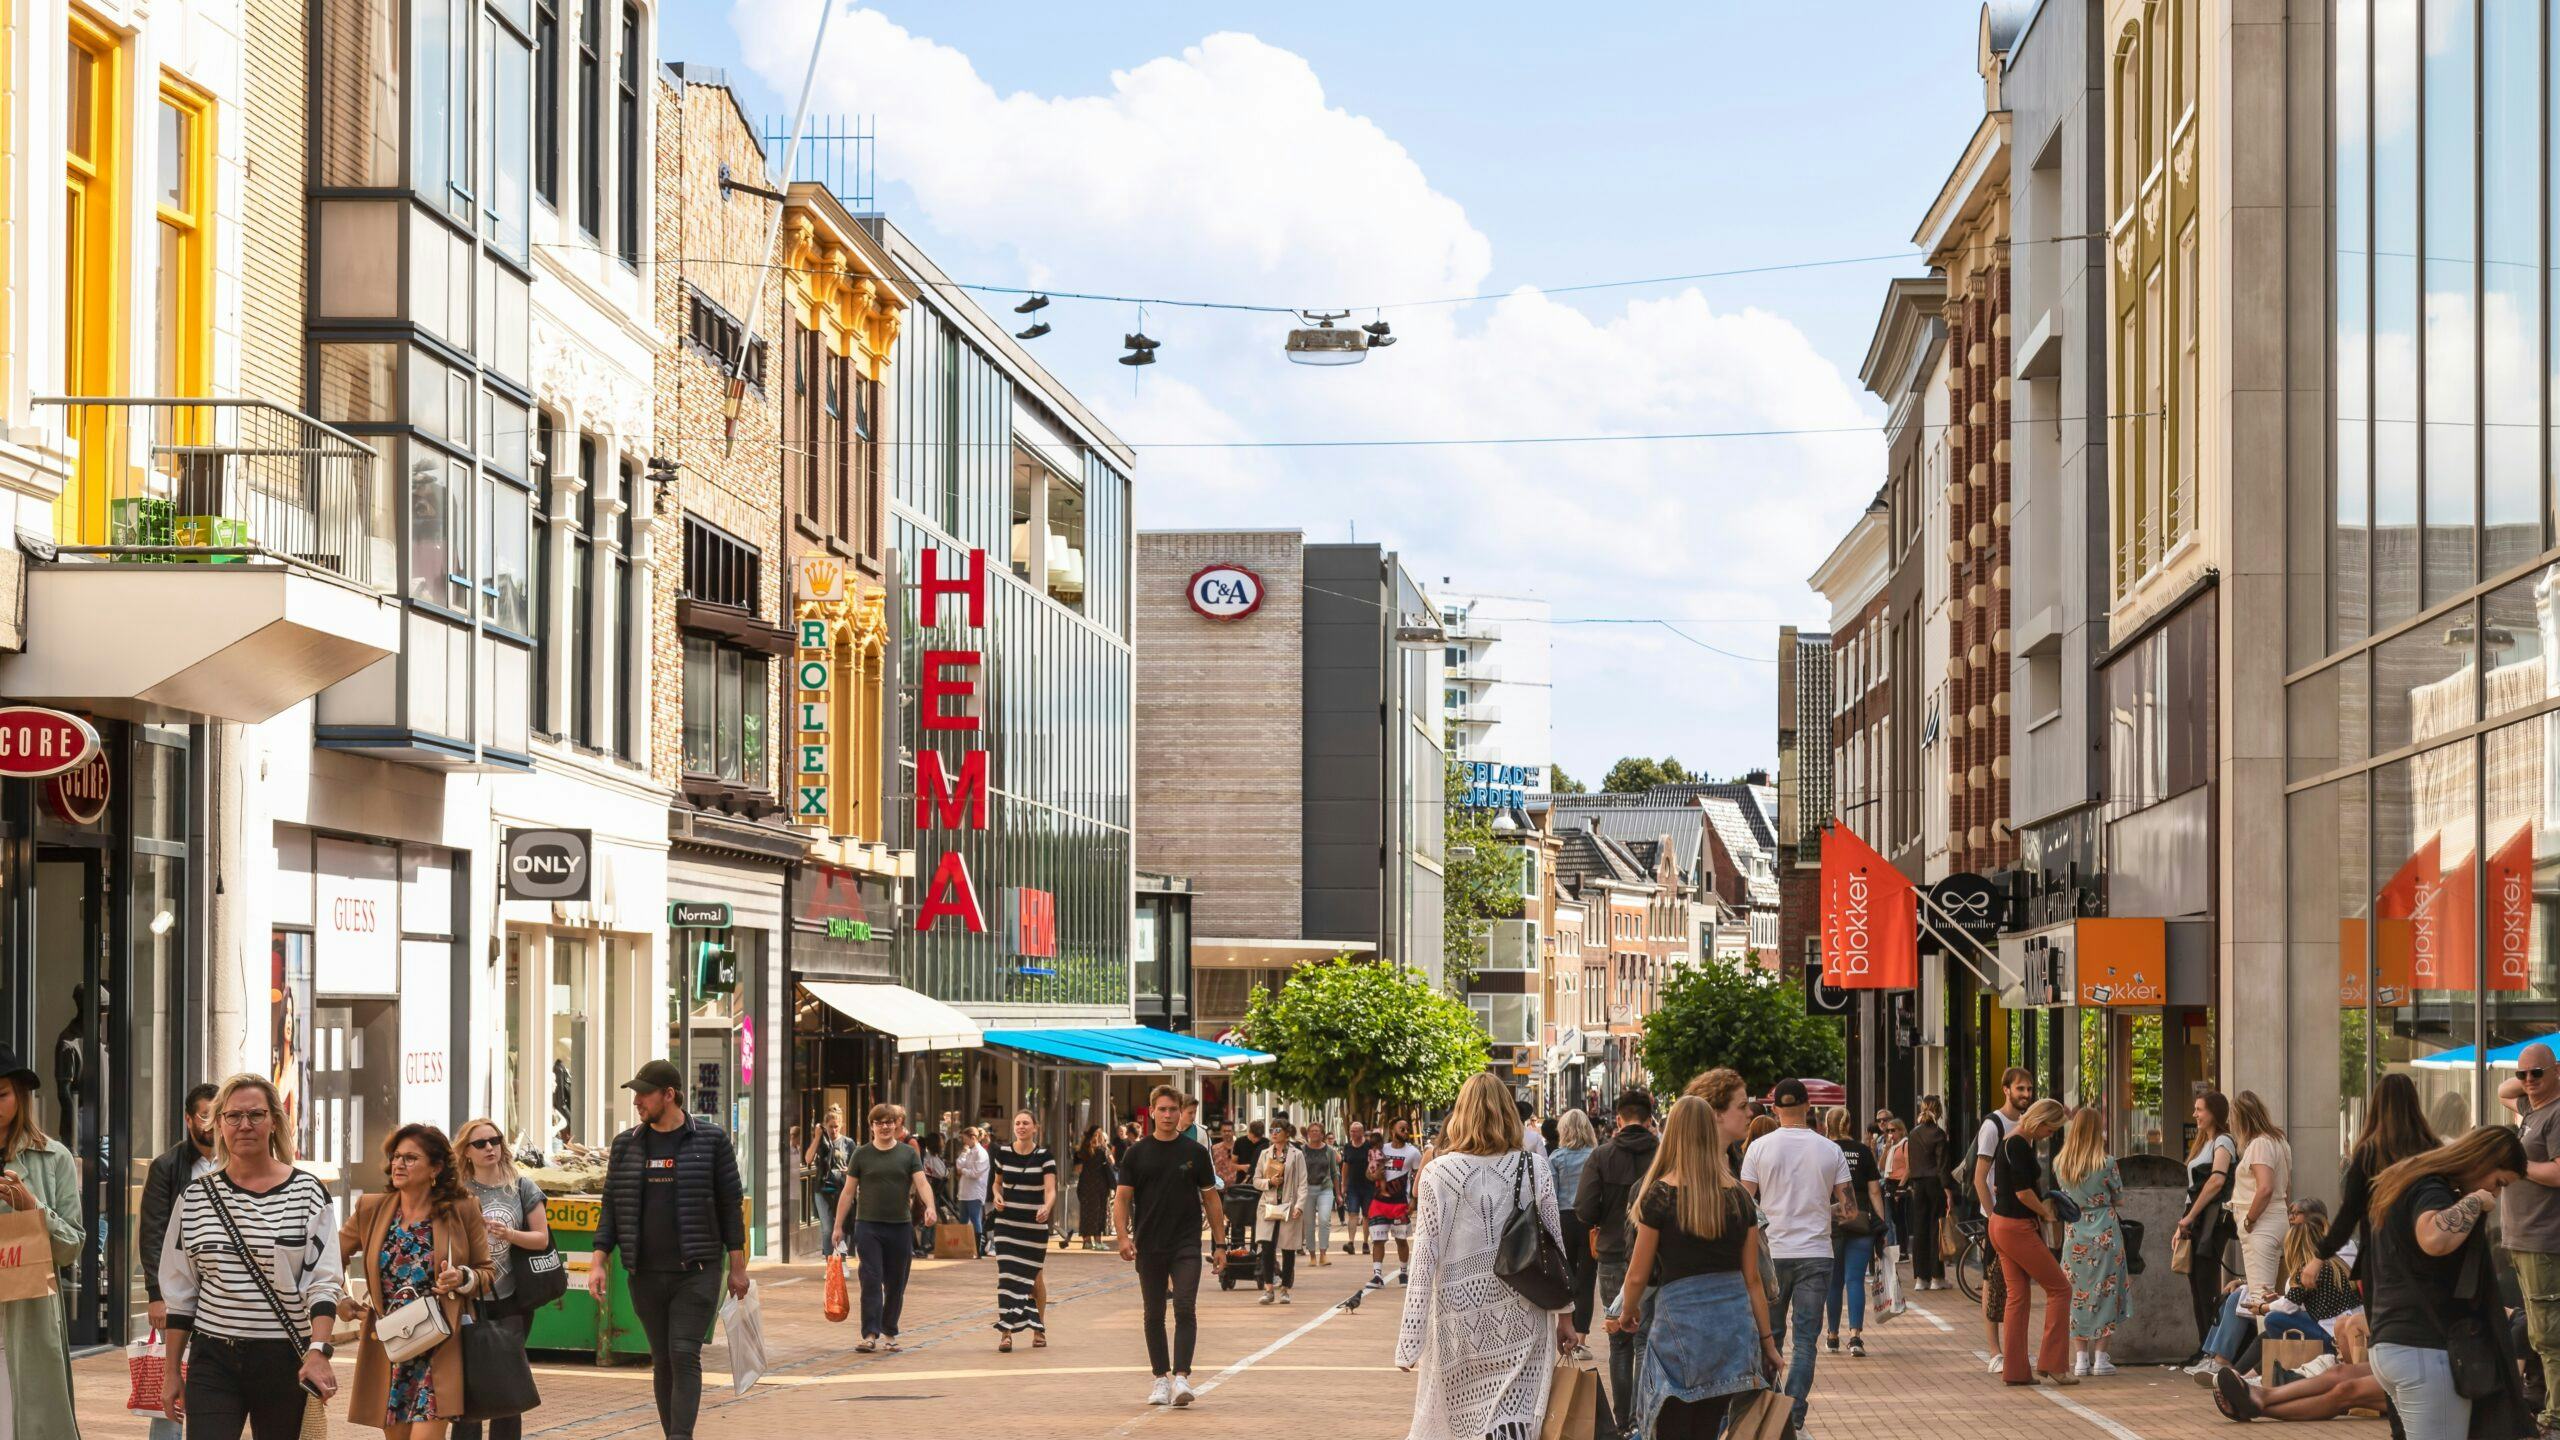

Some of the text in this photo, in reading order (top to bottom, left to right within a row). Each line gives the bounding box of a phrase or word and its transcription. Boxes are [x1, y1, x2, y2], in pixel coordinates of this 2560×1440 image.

[1200, 579, 1250, 605] C&A
[800, 620, 827, 815] ROLEX
[914, 548, 990, 932] HEMA
[1452, 762, 1525, 786] SBLAD
[1460, 787, 1524, 810] ORDEN
[511, 855, 582, 874] ONLY
[335, 897, 376, 932] GUESS
[678, 907, 722, 922] Normal
[2083, 982, 2162, 1000] bkker.
[406, 1052, 444, 1085] GUESS
[215, 1203, 232, 1226] REGULAR
[228, 1227, 242, 1246] NEVER
[240, 1248, 254, 1269] SIMPLE
